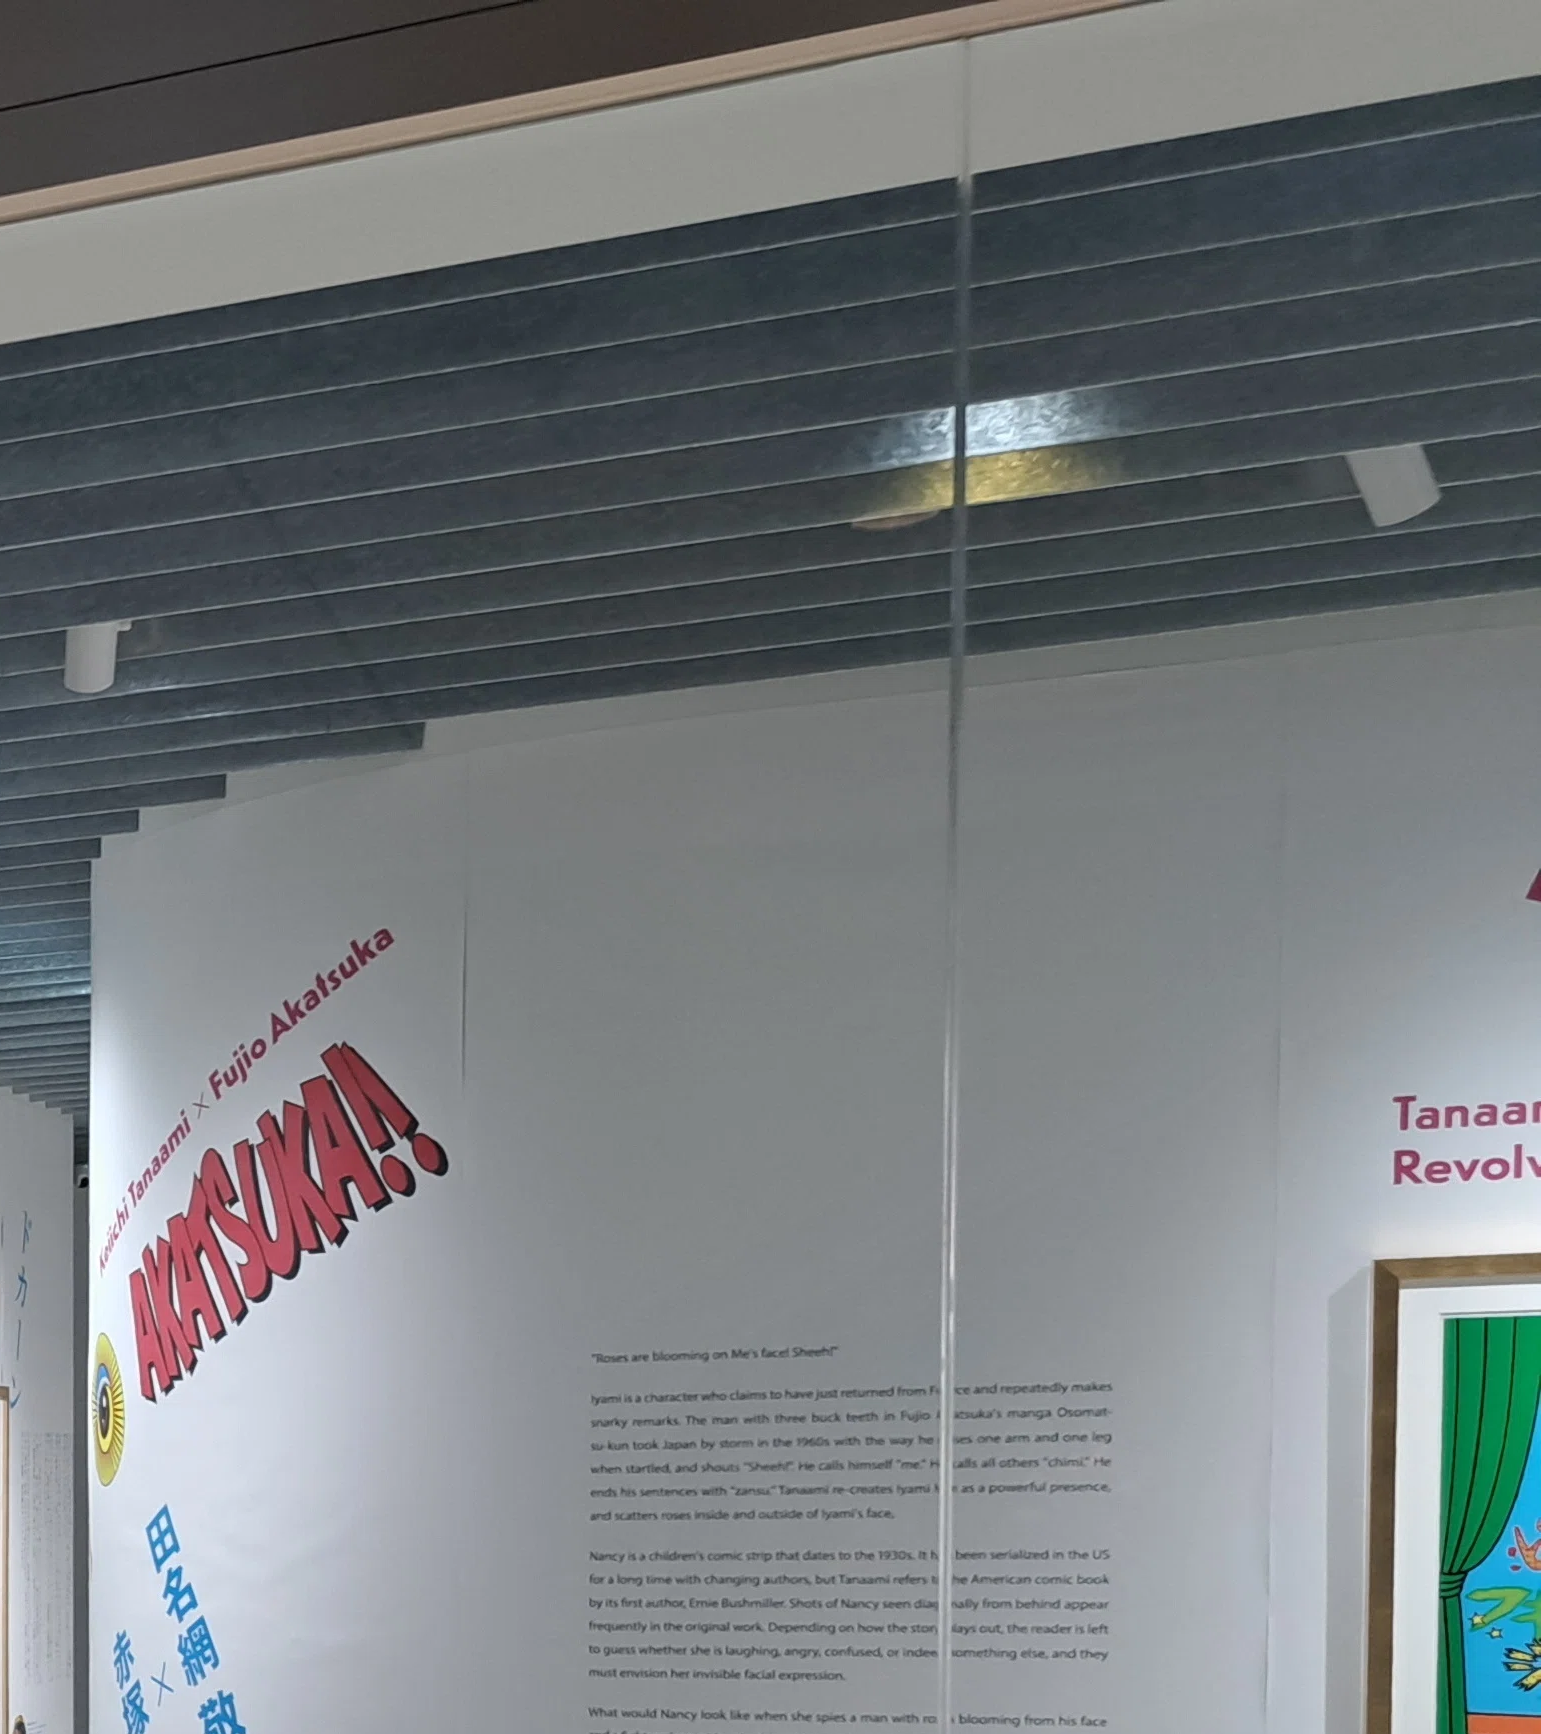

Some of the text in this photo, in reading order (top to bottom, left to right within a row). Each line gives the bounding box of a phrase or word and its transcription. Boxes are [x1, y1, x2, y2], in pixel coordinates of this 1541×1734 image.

[99, 1198, 130, 1275] Keiichi
[127, 1110, 191, 1209] Tanaami
[207, 1040, 267, 1101] Fujio
[269, 926, 396, 1045] Akatsuka
[1392, 1095, 1541, 1131] Tanaa
